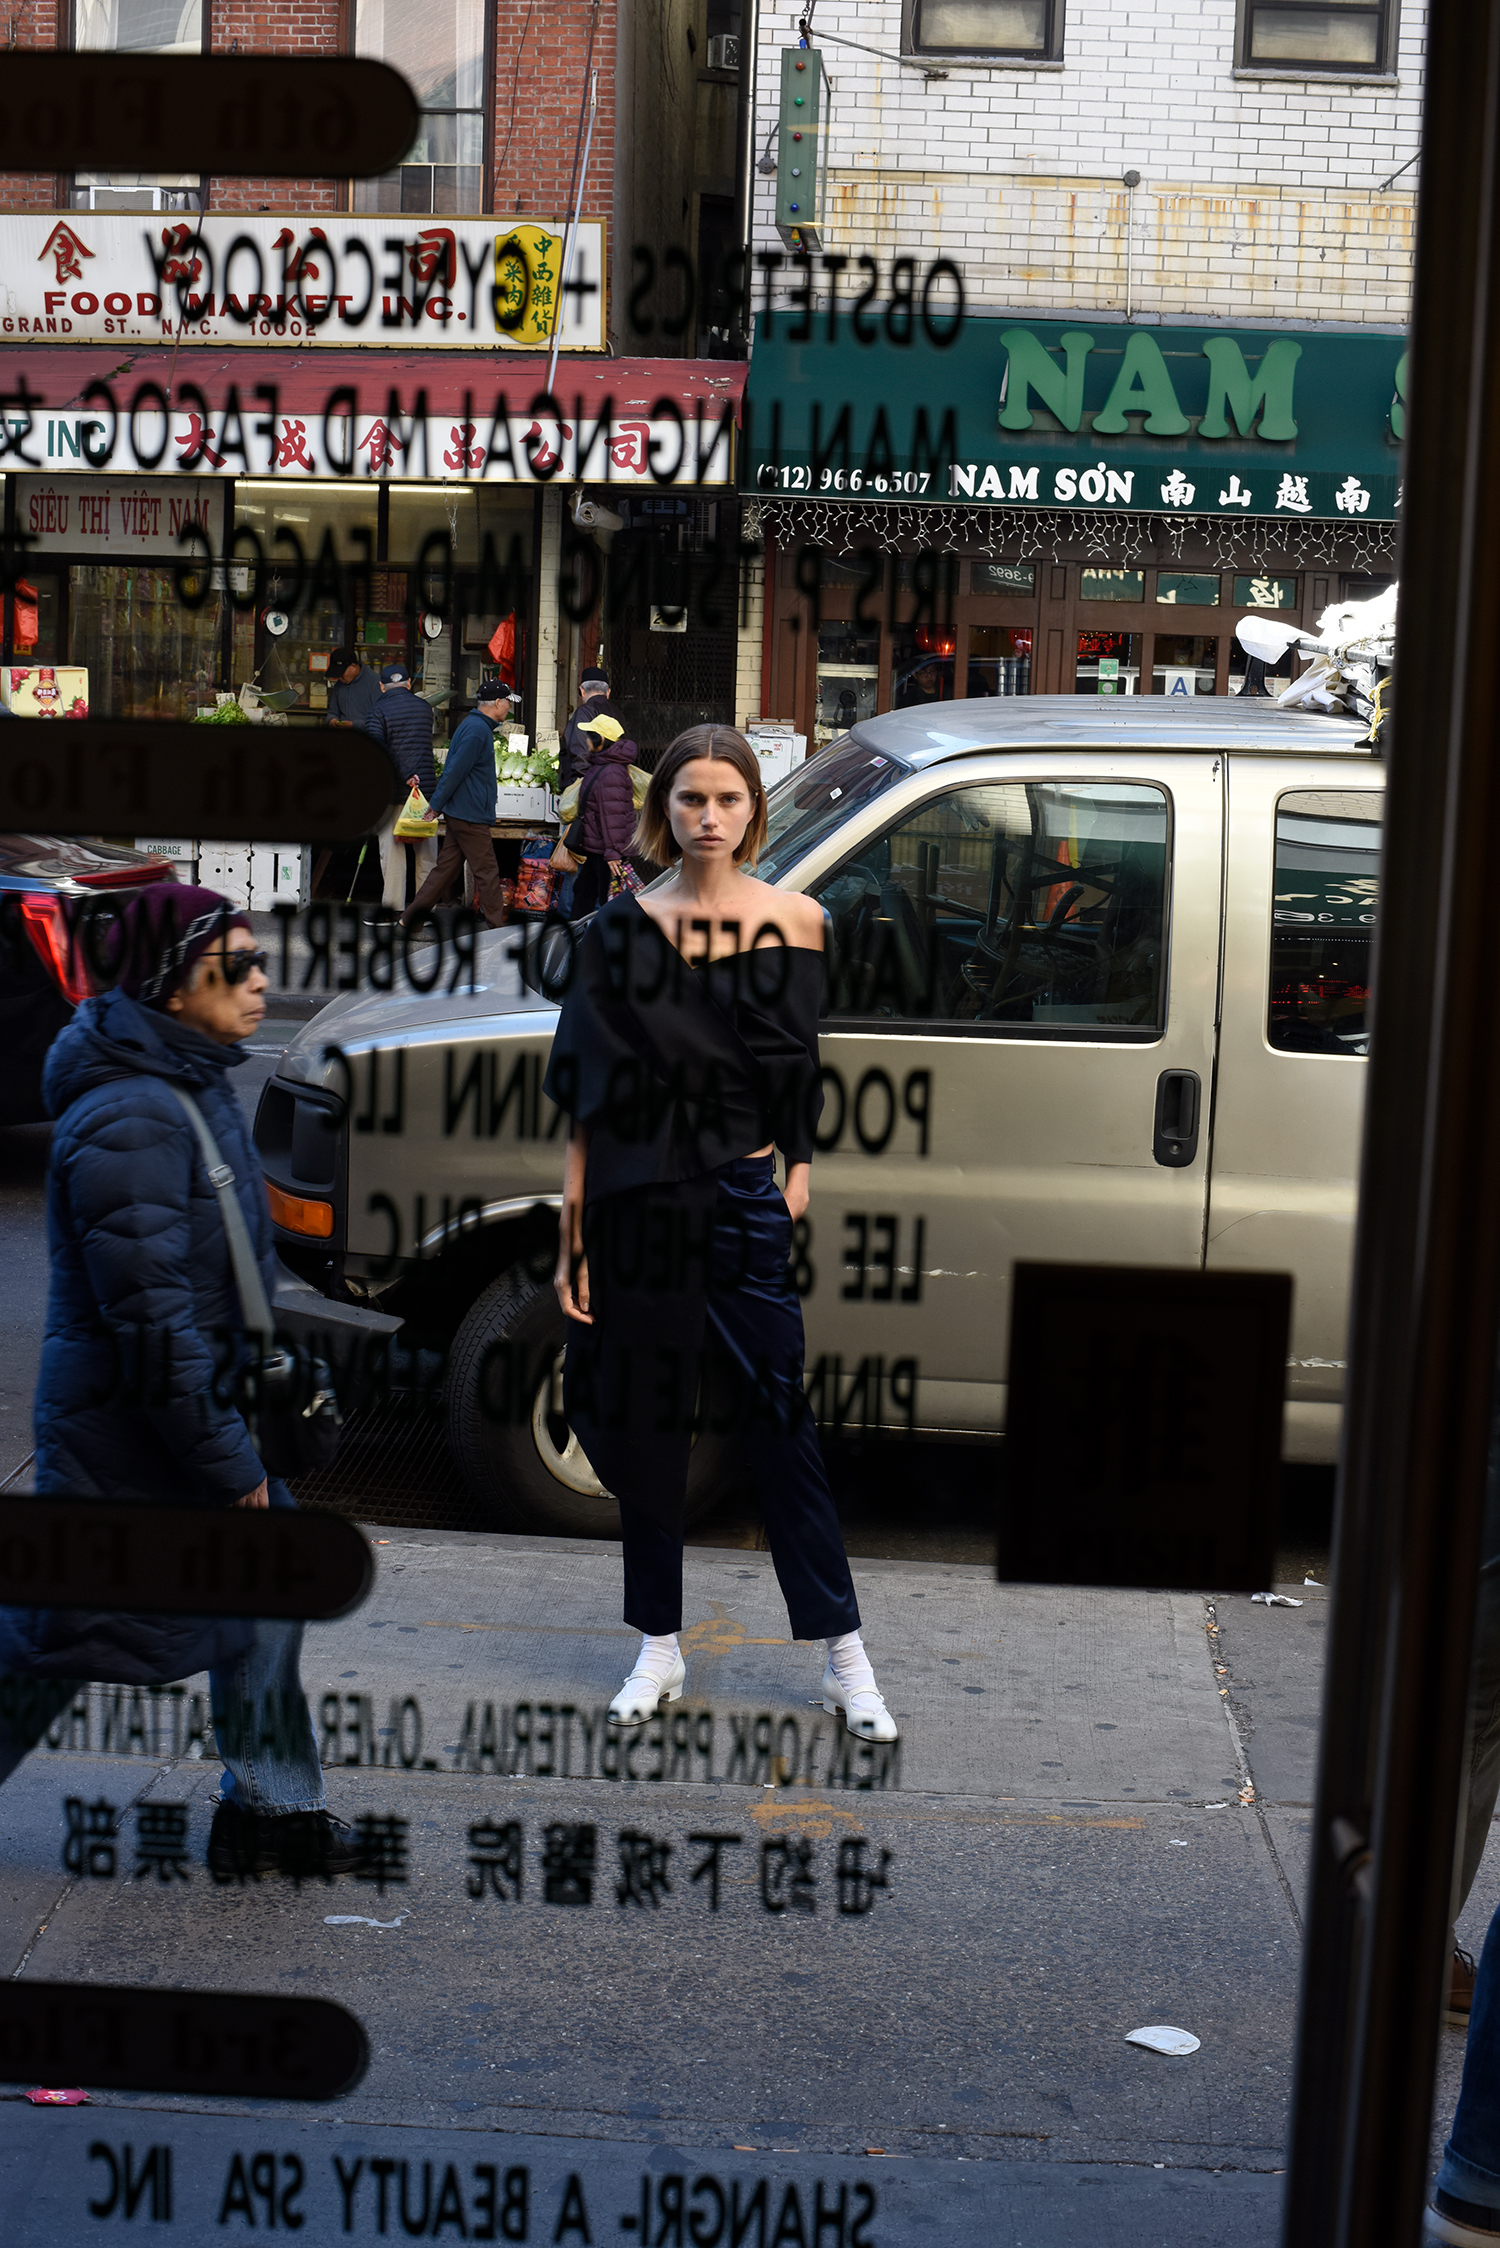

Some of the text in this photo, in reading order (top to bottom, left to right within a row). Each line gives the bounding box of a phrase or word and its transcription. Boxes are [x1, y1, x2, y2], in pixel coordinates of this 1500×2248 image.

[3, 316, 73, 334] GRAND
[249, 319, 317, 337] 10002
[44, 291, 467, 321] FOOD MARKET INC.
[998, 328, 1303, 441] NAM
[174, 412, 651, 475] 大成食品公司
[819, 467, 932, 494] 966-6507
[948, 463, 1040, 500] NAM
[1053, 461, 1136, 504] SƠN
[1160, 468, 1403, 515] 南山越南
[168, 498, 211, 538] NAM
[147, 844, 182, 855] CABBAGE
